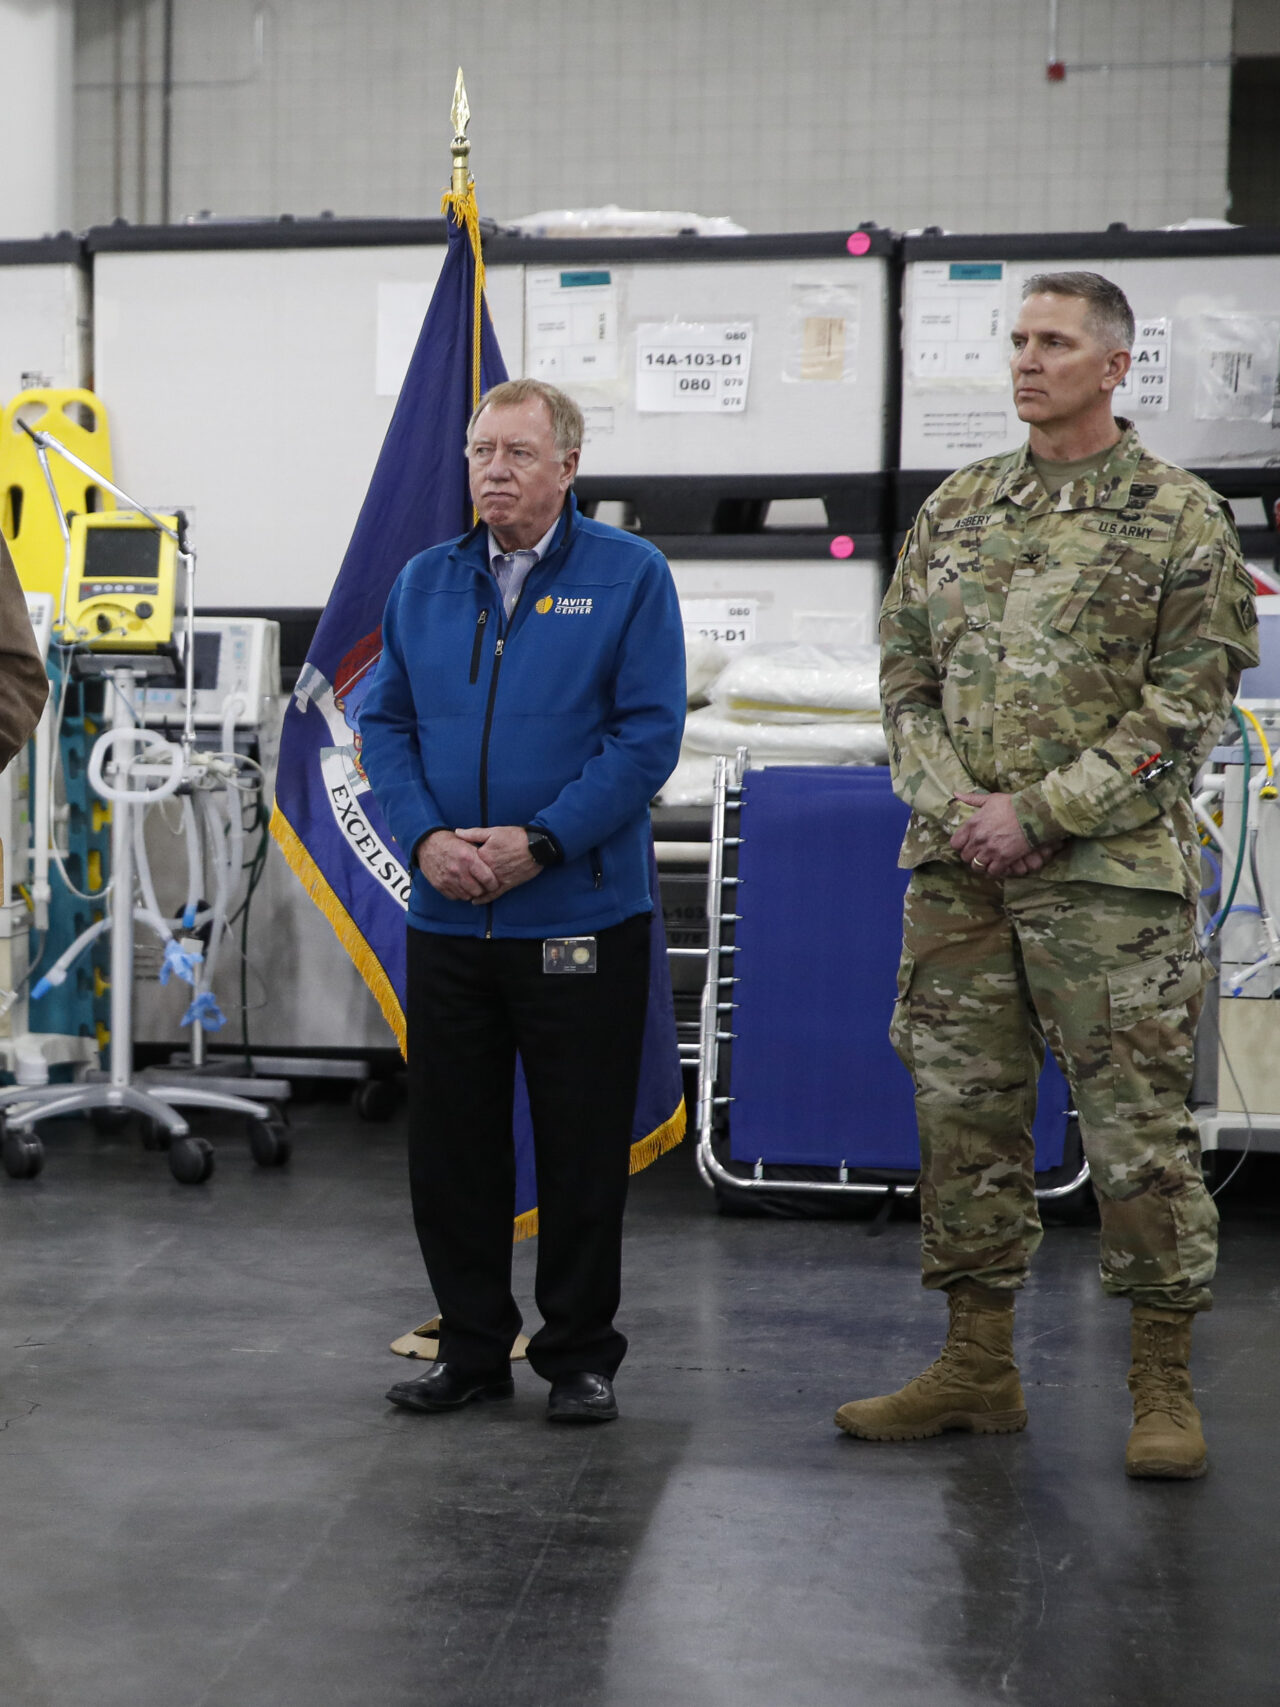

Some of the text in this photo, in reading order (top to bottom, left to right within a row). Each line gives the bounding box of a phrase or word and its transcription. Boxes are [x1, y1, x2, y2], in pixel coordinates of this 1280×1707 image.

[725, 332, 747, 340] 080
[1143, 327, 1165, 337] 074
[646, 353, 742, 366] 14A-103-D1
[680, 379, 711, 391] 080
[1141, 375, 1164, 385] 073
[1140, 394, 1163, 404] 072
[954, 515, 992, 528] ASBERY
[1119, 525, 1154, 540] ARMY
[556, 597, 593, 606] JAVITS
[554, 607, 592, 615] CENTER
[331, 784, 412, 903] EXCELSIO
